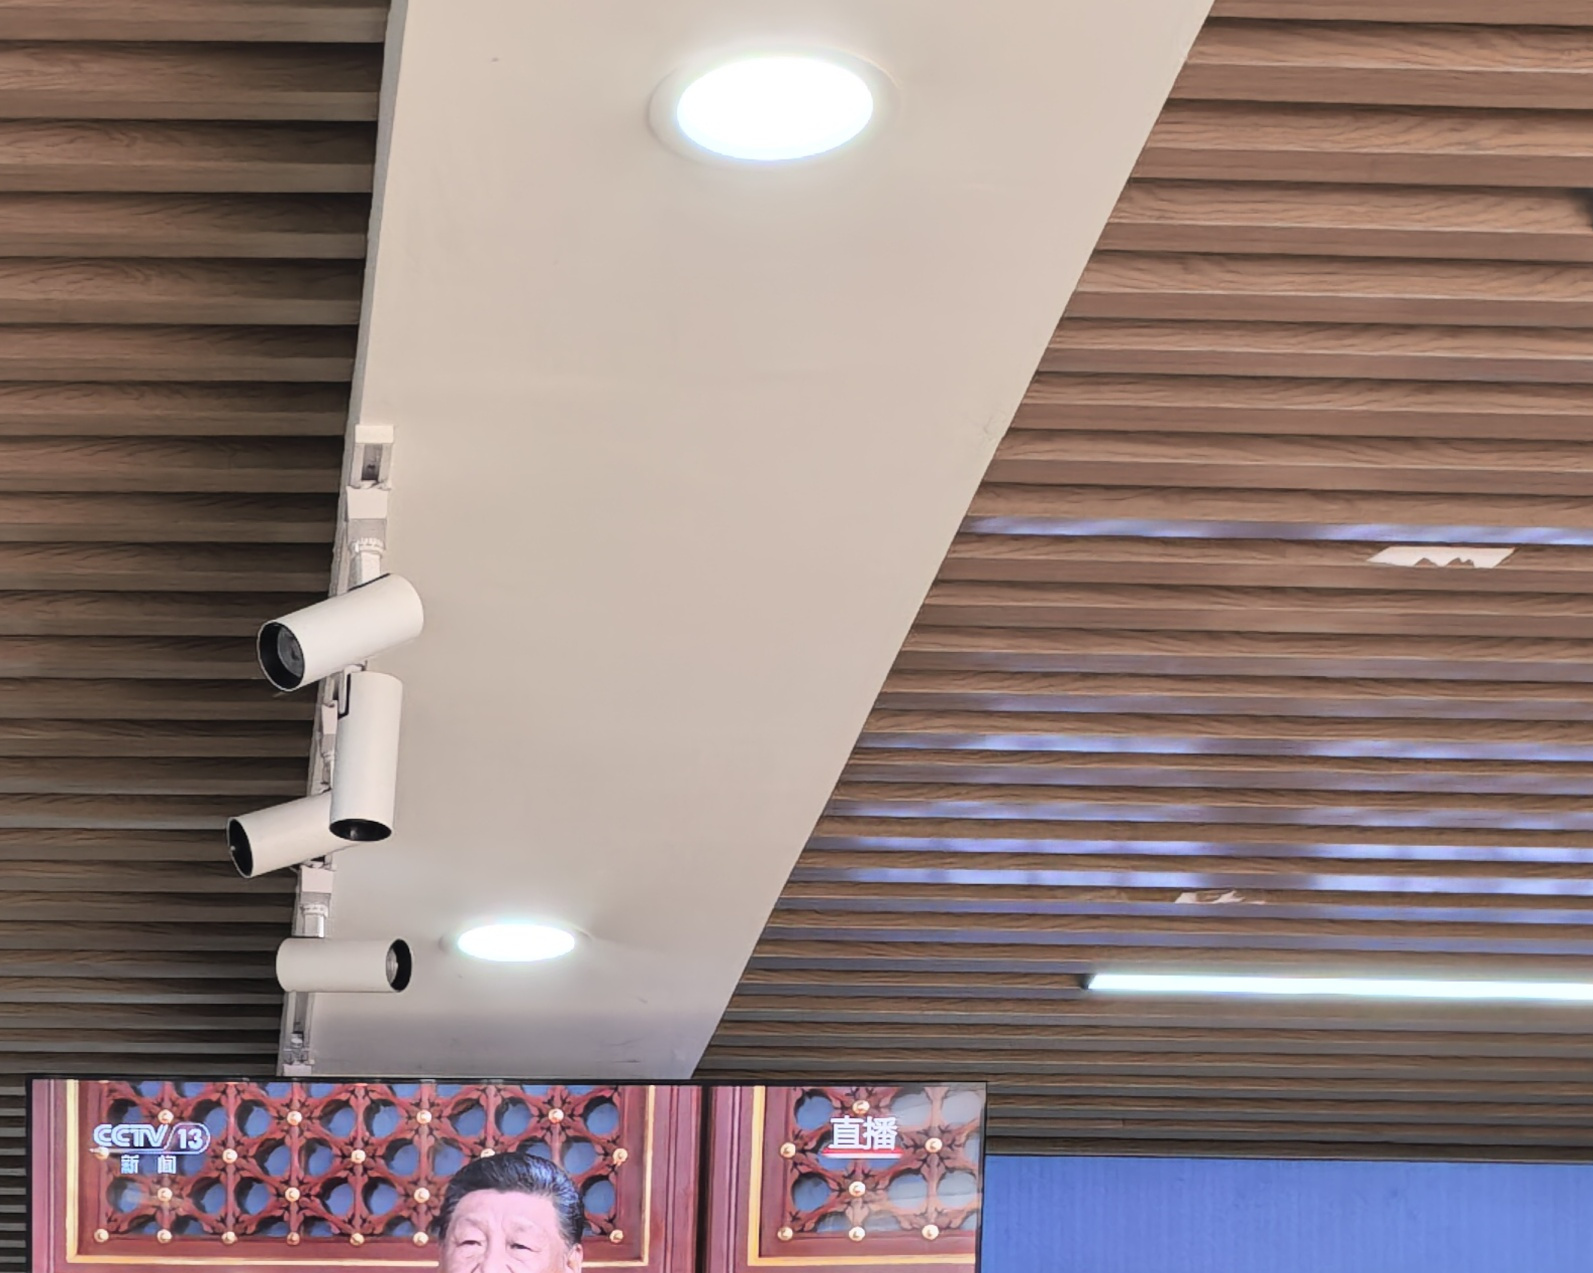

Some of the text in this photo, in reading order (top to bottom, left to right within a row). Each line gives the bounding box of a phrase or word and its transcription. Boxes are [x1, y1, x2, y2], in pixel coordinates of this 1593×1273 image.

[93, 1123, 204, 1150] CCTV 13
[828, 1115, 898, 1150] 直播
[120, 1154, 177, 1174] 新闻
